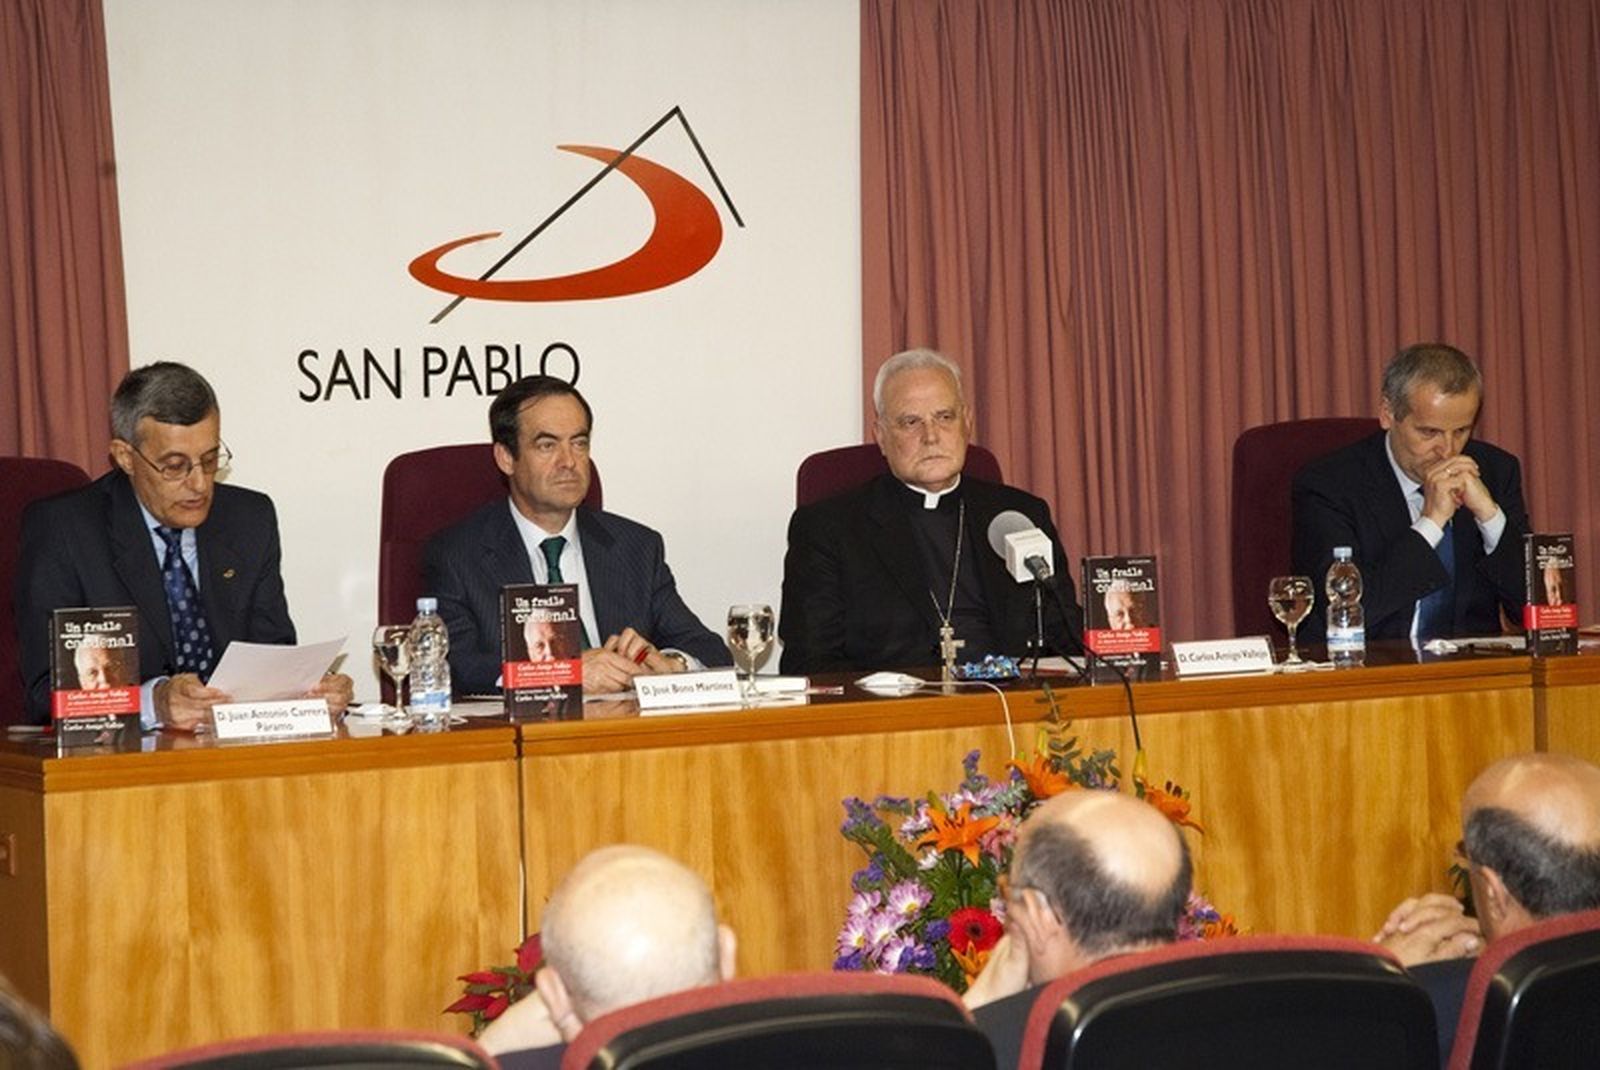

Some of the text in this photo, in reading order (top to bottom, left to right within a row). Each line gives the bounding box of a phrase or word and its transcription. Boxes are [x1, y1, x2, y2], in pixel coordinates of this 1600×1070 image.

[297, 348, 401, 402] SAN
[64, 621, 122, 633] Un fraile
[1189, 652, 1215, 662] Carlos
[1215, 651, 1240, 661] Amigo
[671, 683, 694, 693] Bono
[228, 710, 249, 723] Juan
[251, 708, 289, 719] Antonio
